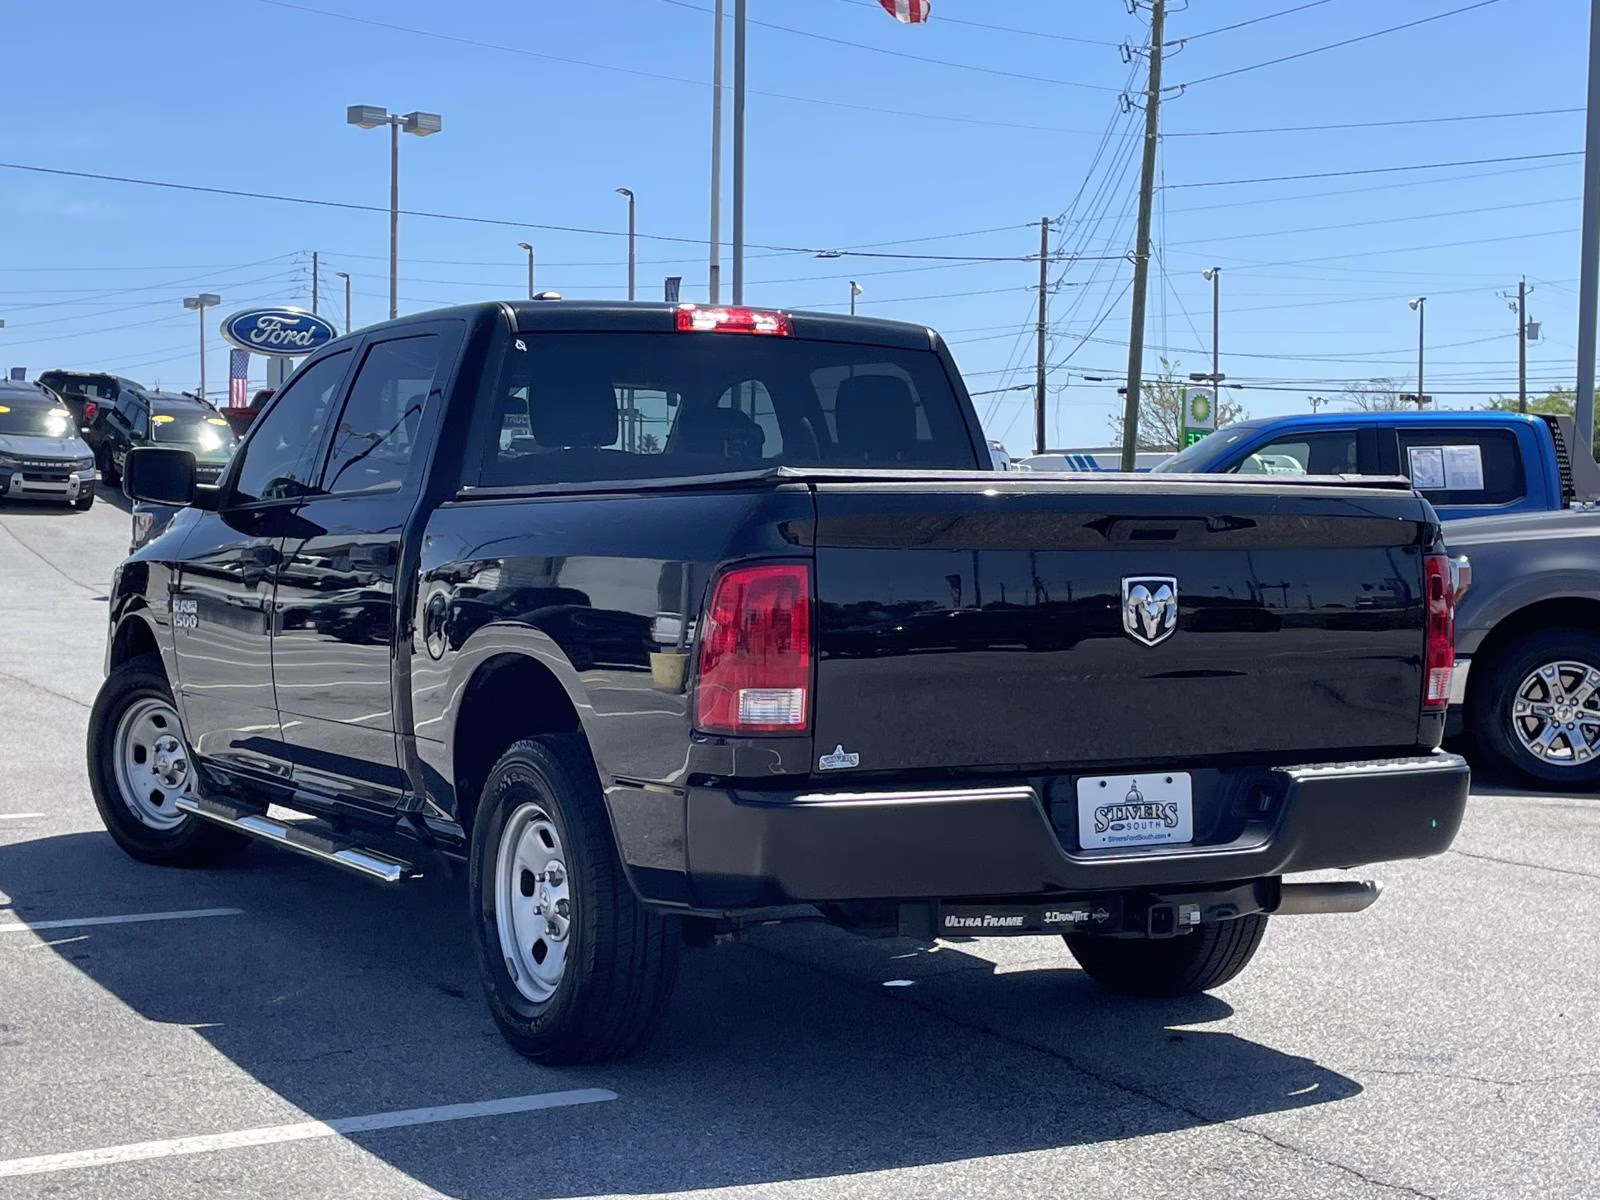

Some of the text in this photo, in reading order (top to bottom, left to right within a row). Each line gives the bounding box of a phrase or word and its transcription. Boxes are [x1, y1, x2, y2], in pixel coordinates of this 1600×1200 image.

[250, 316, 316, 345] Ford
[1094, 802, 1178, 834] STIVERS
[1126, 821, 1161, 831] SOUTH
